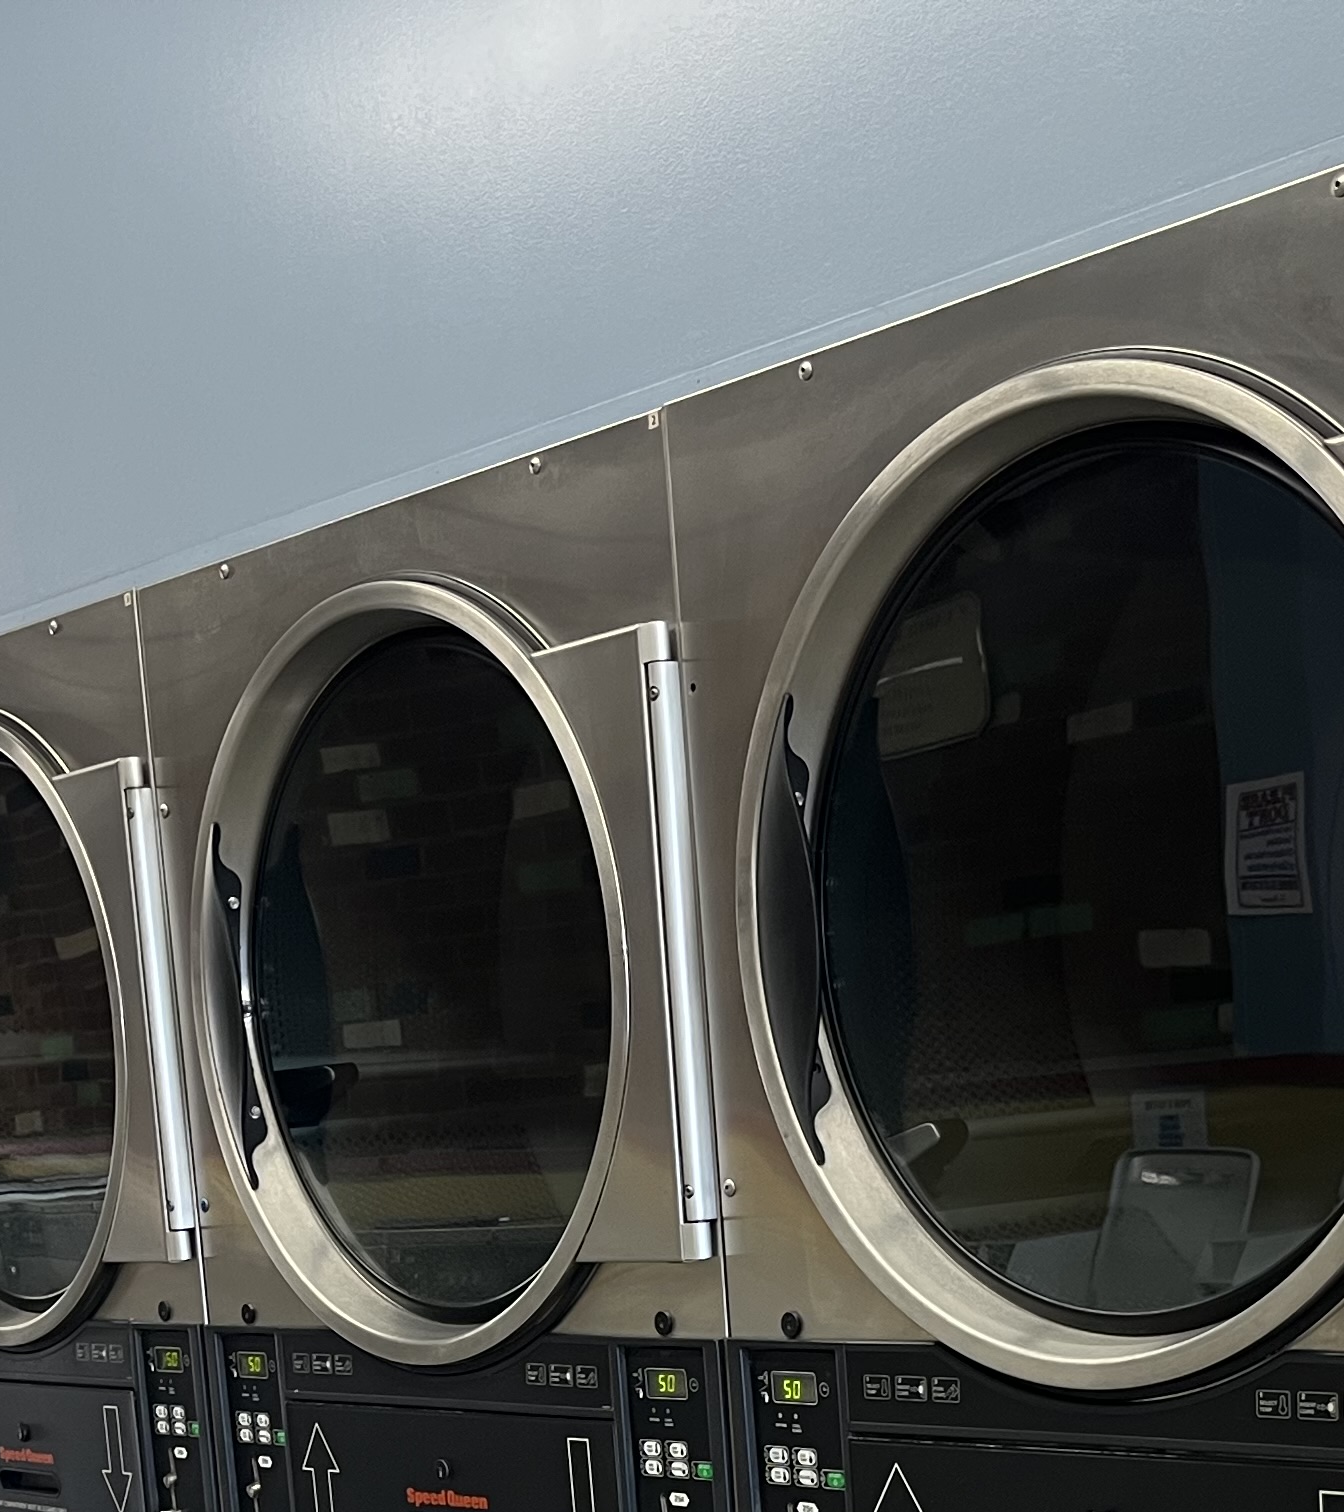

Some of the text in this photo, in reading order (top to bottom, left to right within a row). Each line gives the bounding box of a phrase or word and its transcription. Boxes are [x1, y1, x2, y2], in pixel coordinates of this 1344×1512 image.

[247, 1356, 261, 1372] 50
[658, 1374, 676, 1393] 50
[783, 1379, 801, 1399] 50
[406, 1487, 488, 1510] Speed Queen
